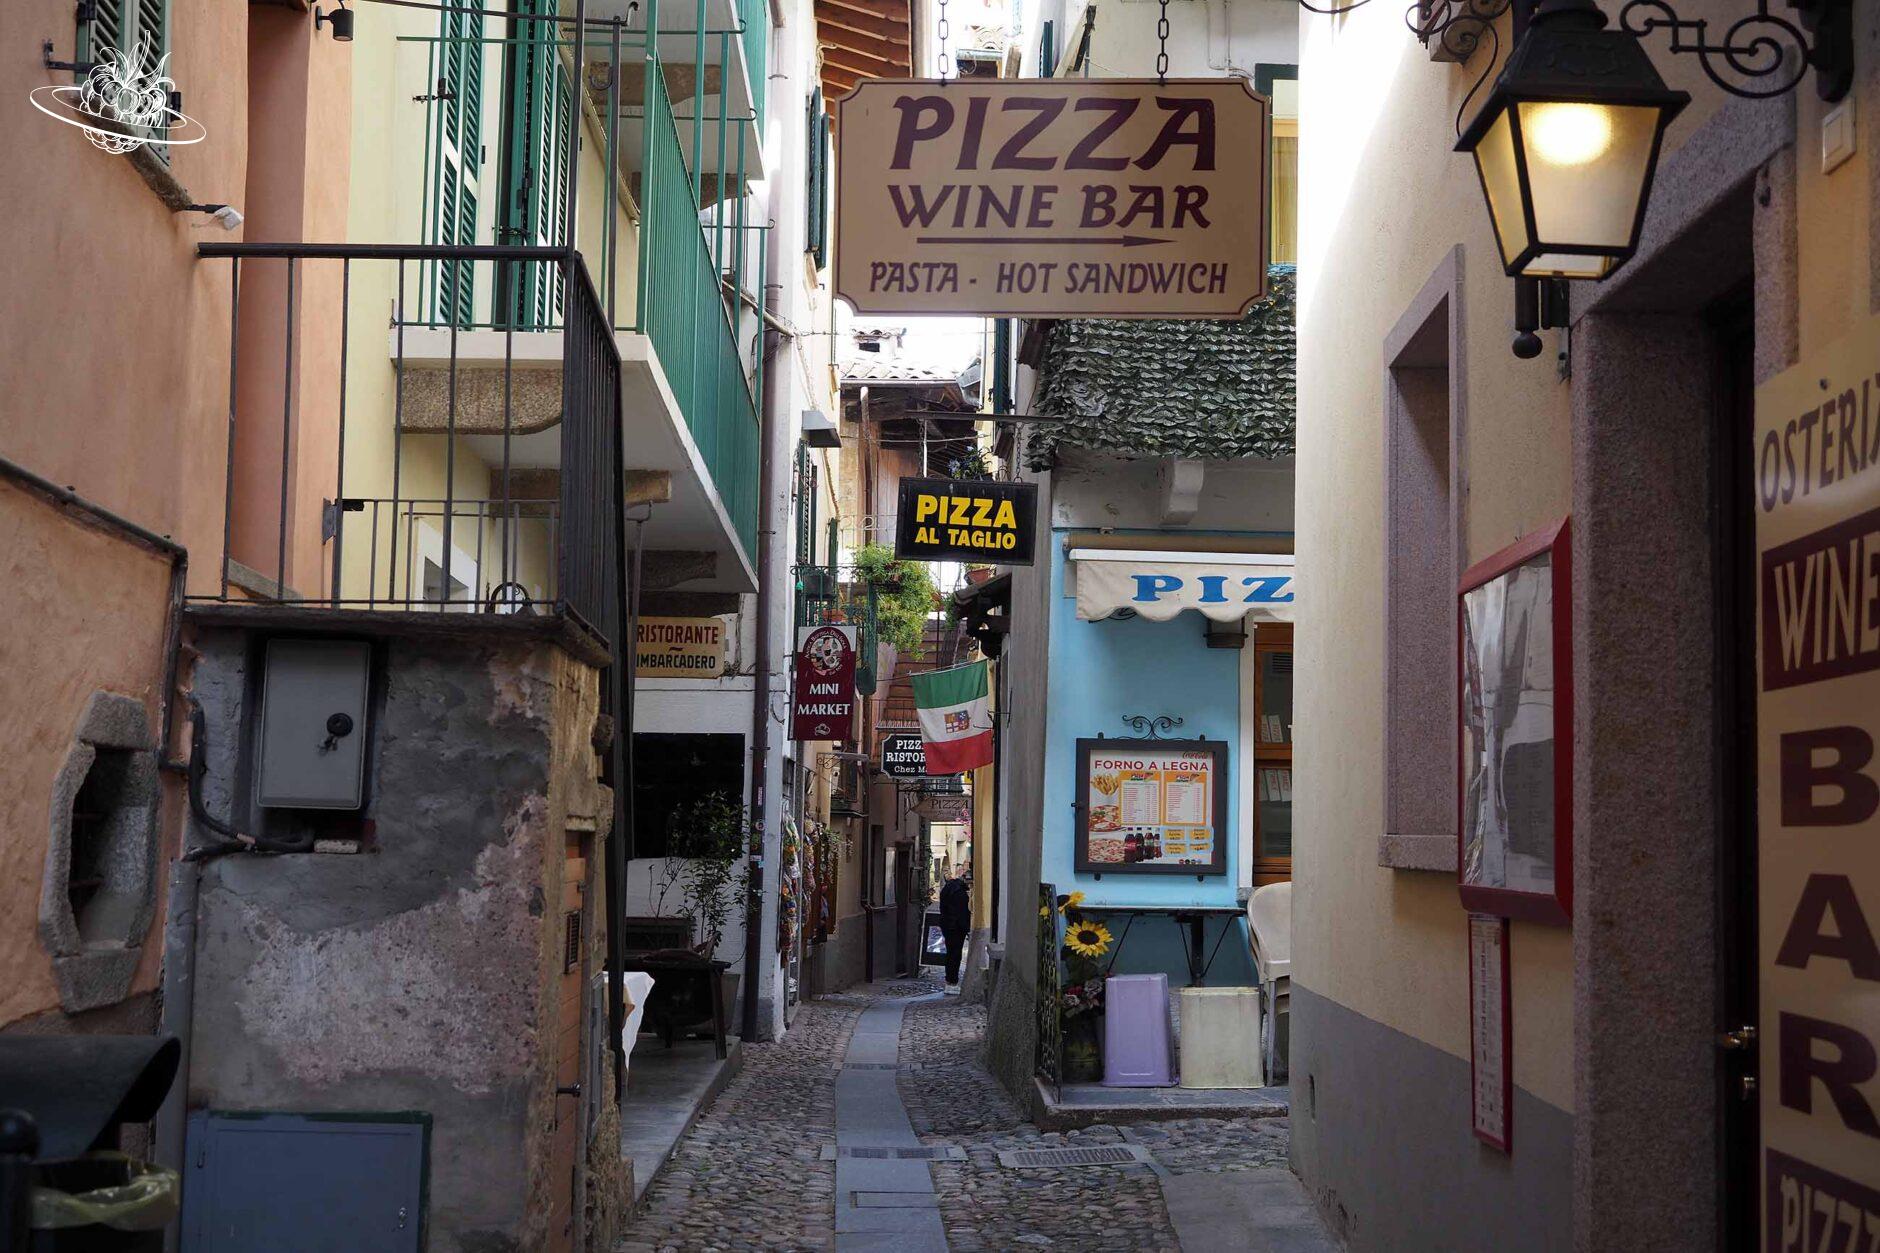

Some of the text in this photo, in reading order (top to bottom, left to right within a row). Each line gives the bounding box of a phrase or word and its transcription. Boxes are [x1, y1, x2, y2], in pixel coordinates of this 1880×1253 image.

[890, 95, 1216, 171] PIZZA
[888, 185, 1211, 229] WINE BAR
[869, 261, 959, 293] PASTA
[996, 262, 1059, 294] HOT
[1065, 262, 1228, 295] SANDWICH
[916, 494, 1017, 529] PIZZA
[914, 527, 1016, 550] AL TAGLIO
[1773, 530, 1880, 672] WINE
[637, 624, 719, 645] RISTORANTE
[637, 654, 716, 669] IMBARCADERO
[809, 683, 839, 695] MINI
[797, 703, 851, 715] MARKET
[896, 740, 924, 750] PIZZ
[894, 765, 916, 773] Chez
[1094, 760, 1209, 771] FORNO A LEGNA
[931, 799, 969, 810] PIZZA
[1774, 725, 1880, 1139] BAR
